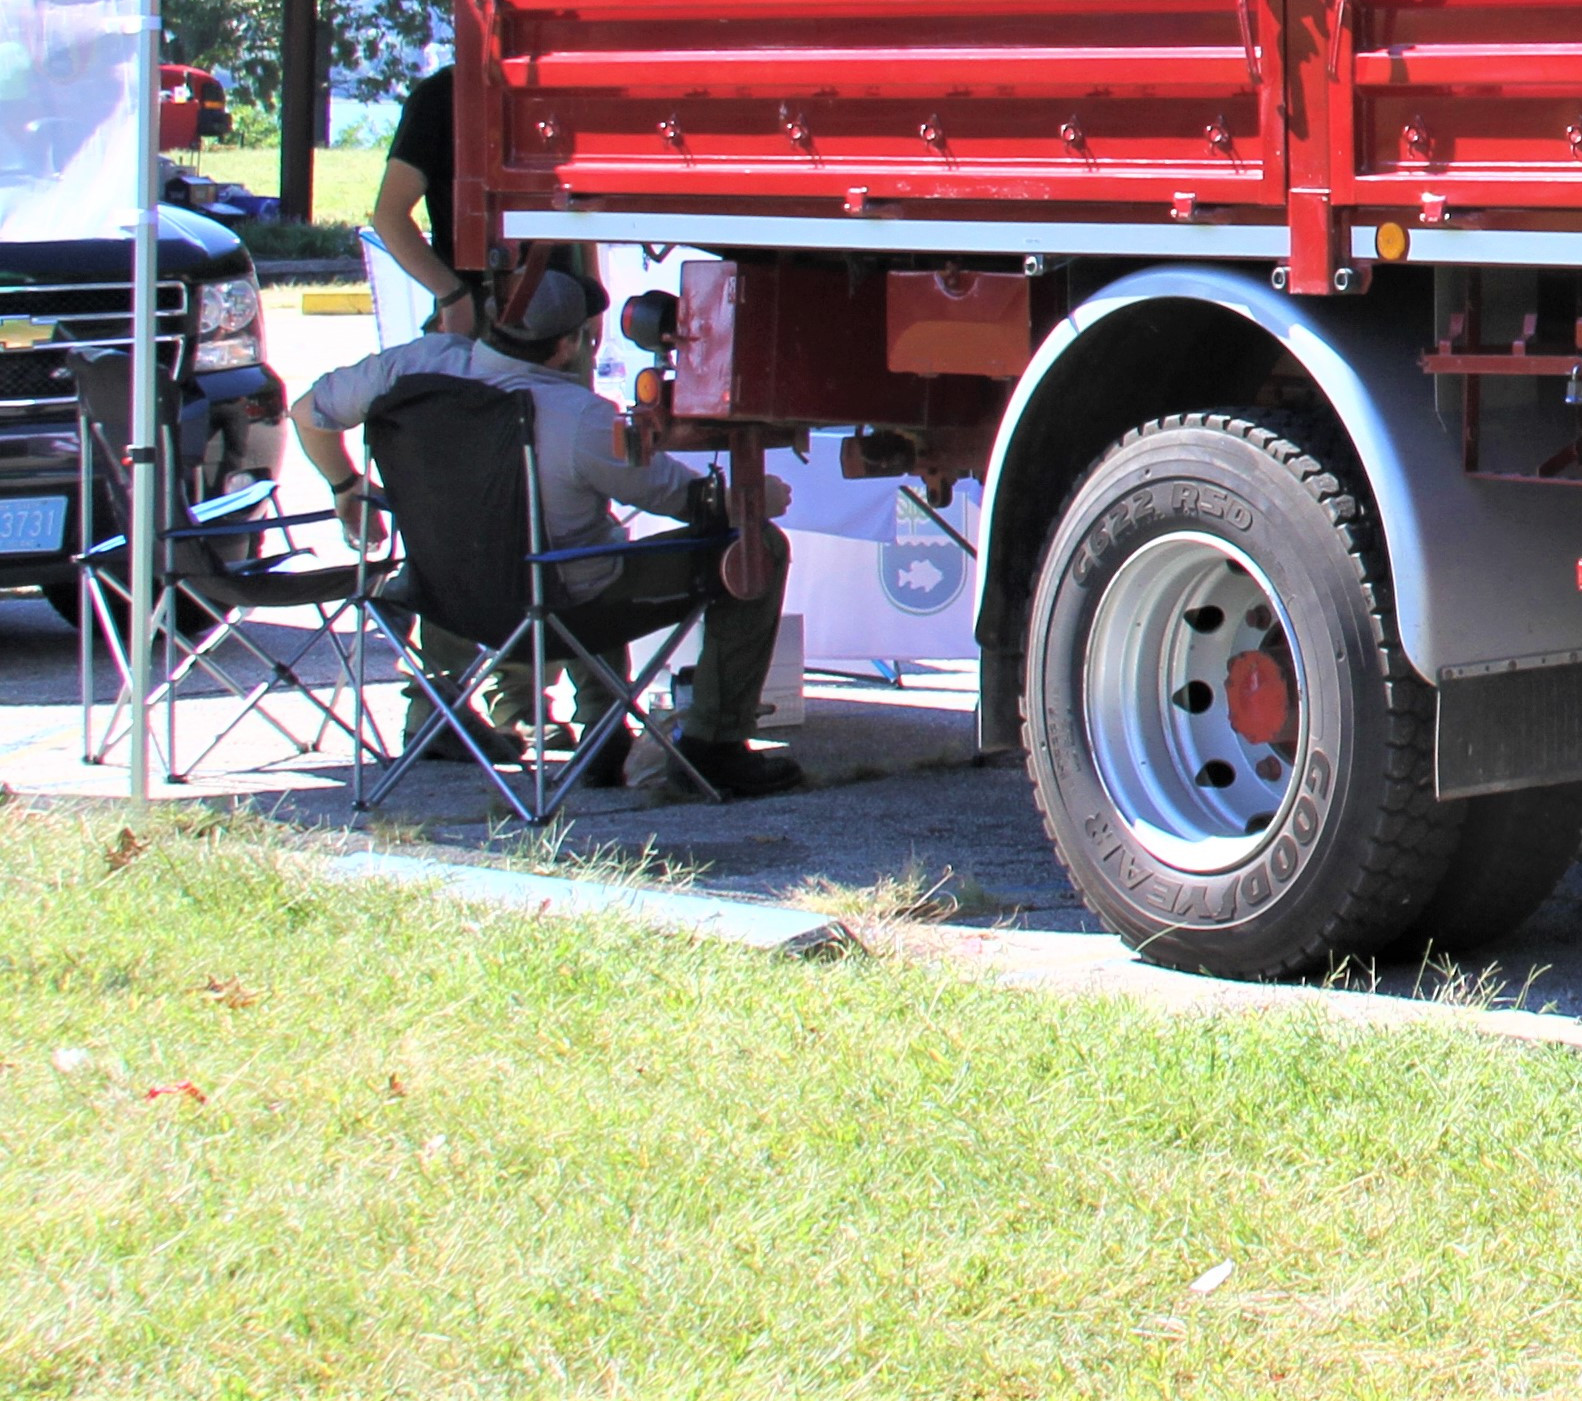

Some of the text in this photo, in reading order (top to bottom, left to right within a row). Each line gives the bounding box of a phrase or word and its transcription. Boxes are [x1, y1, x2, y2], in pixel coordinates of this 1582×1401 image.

[1072, 481, 1254, 587] G622 RSD
[1084, 747, 1332, 923] GOODYEAR
